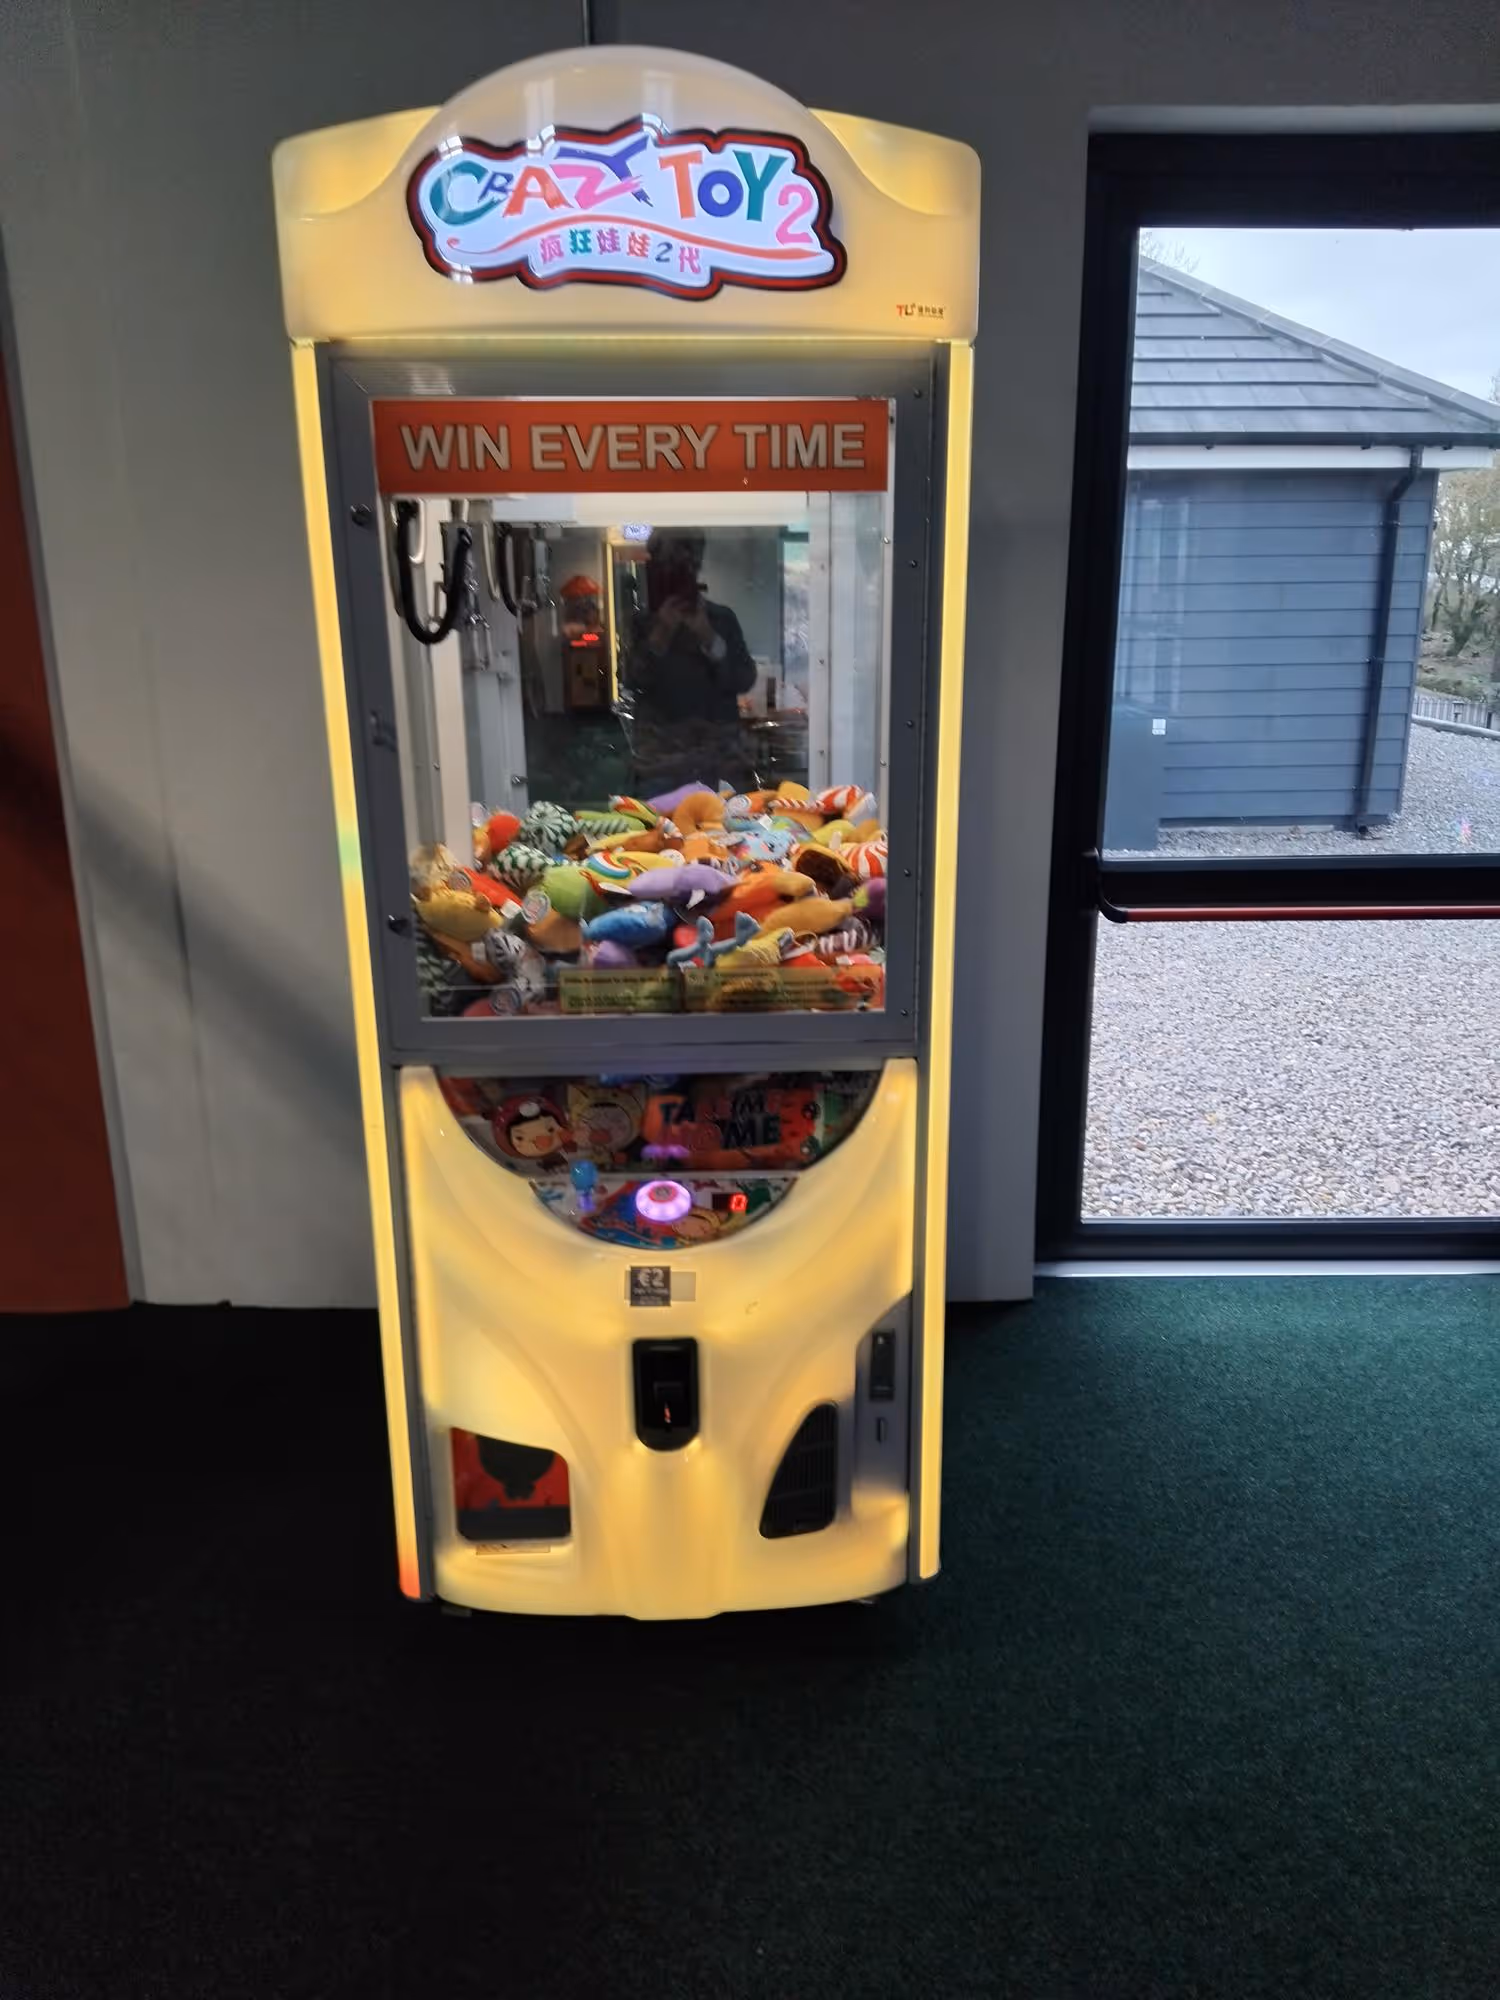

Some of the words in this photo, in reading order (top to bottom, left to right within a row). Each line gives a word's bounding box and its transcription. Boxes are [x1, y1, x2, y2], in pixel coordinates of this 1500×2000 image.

[429, 135, 653, 226] CRAZY
[401, 423, 510, 471] WIN
[530, 423, 718, 471] EVERY
[733, 422, 865, 470] TIME
[731, 1193, 747, 1212] 0
